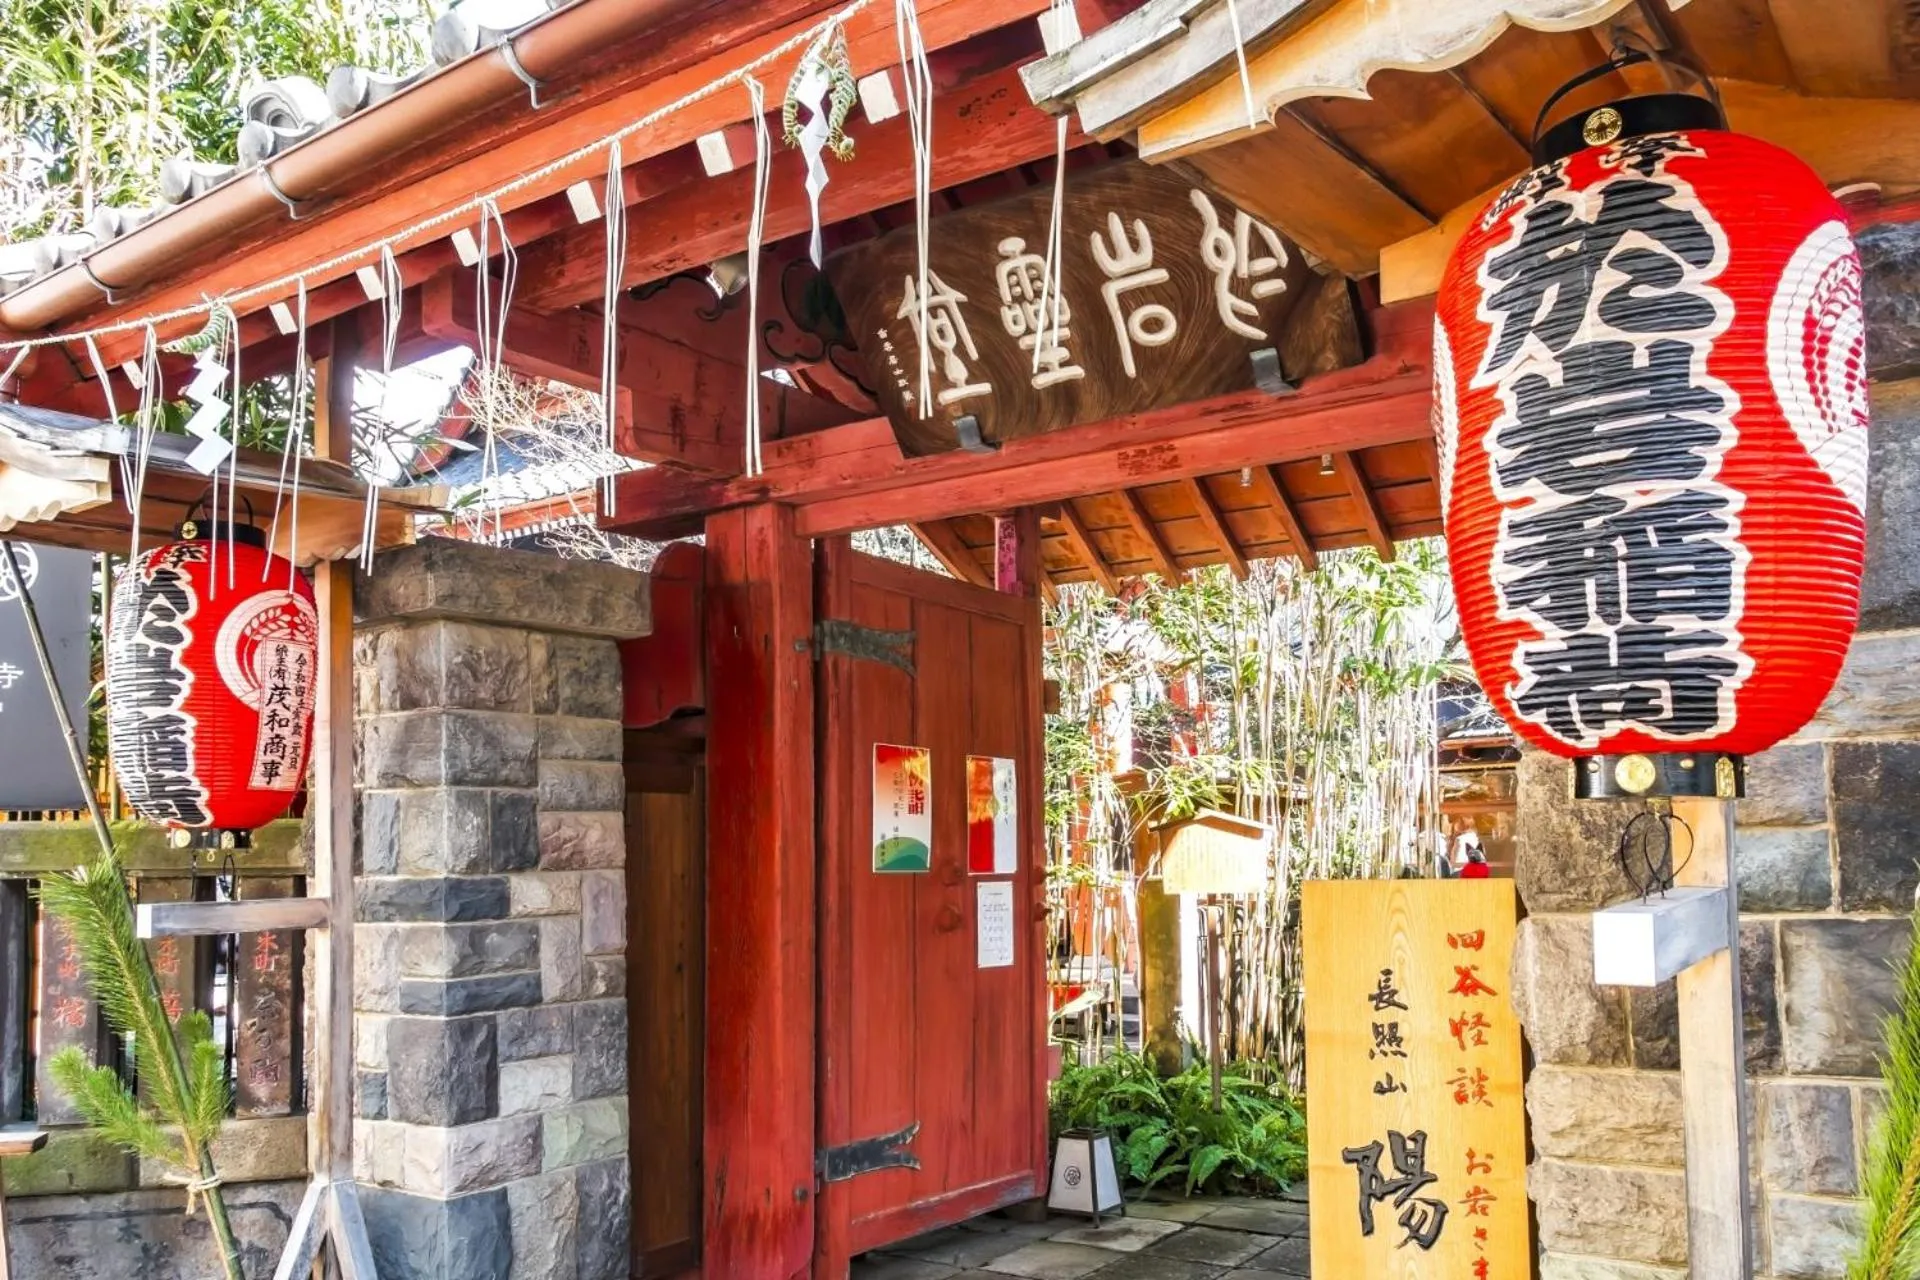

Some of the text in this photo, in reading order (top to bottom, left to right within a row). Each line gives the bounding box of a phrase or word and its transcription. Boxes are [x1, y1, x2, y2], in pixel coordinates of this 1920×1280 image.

[1484, 178, 1739, 745] 於岩稲荷
[1341, 968, 1449, 1251] 長照山 陽
[1446, 928, 1498, 1108] 四谷怪談
